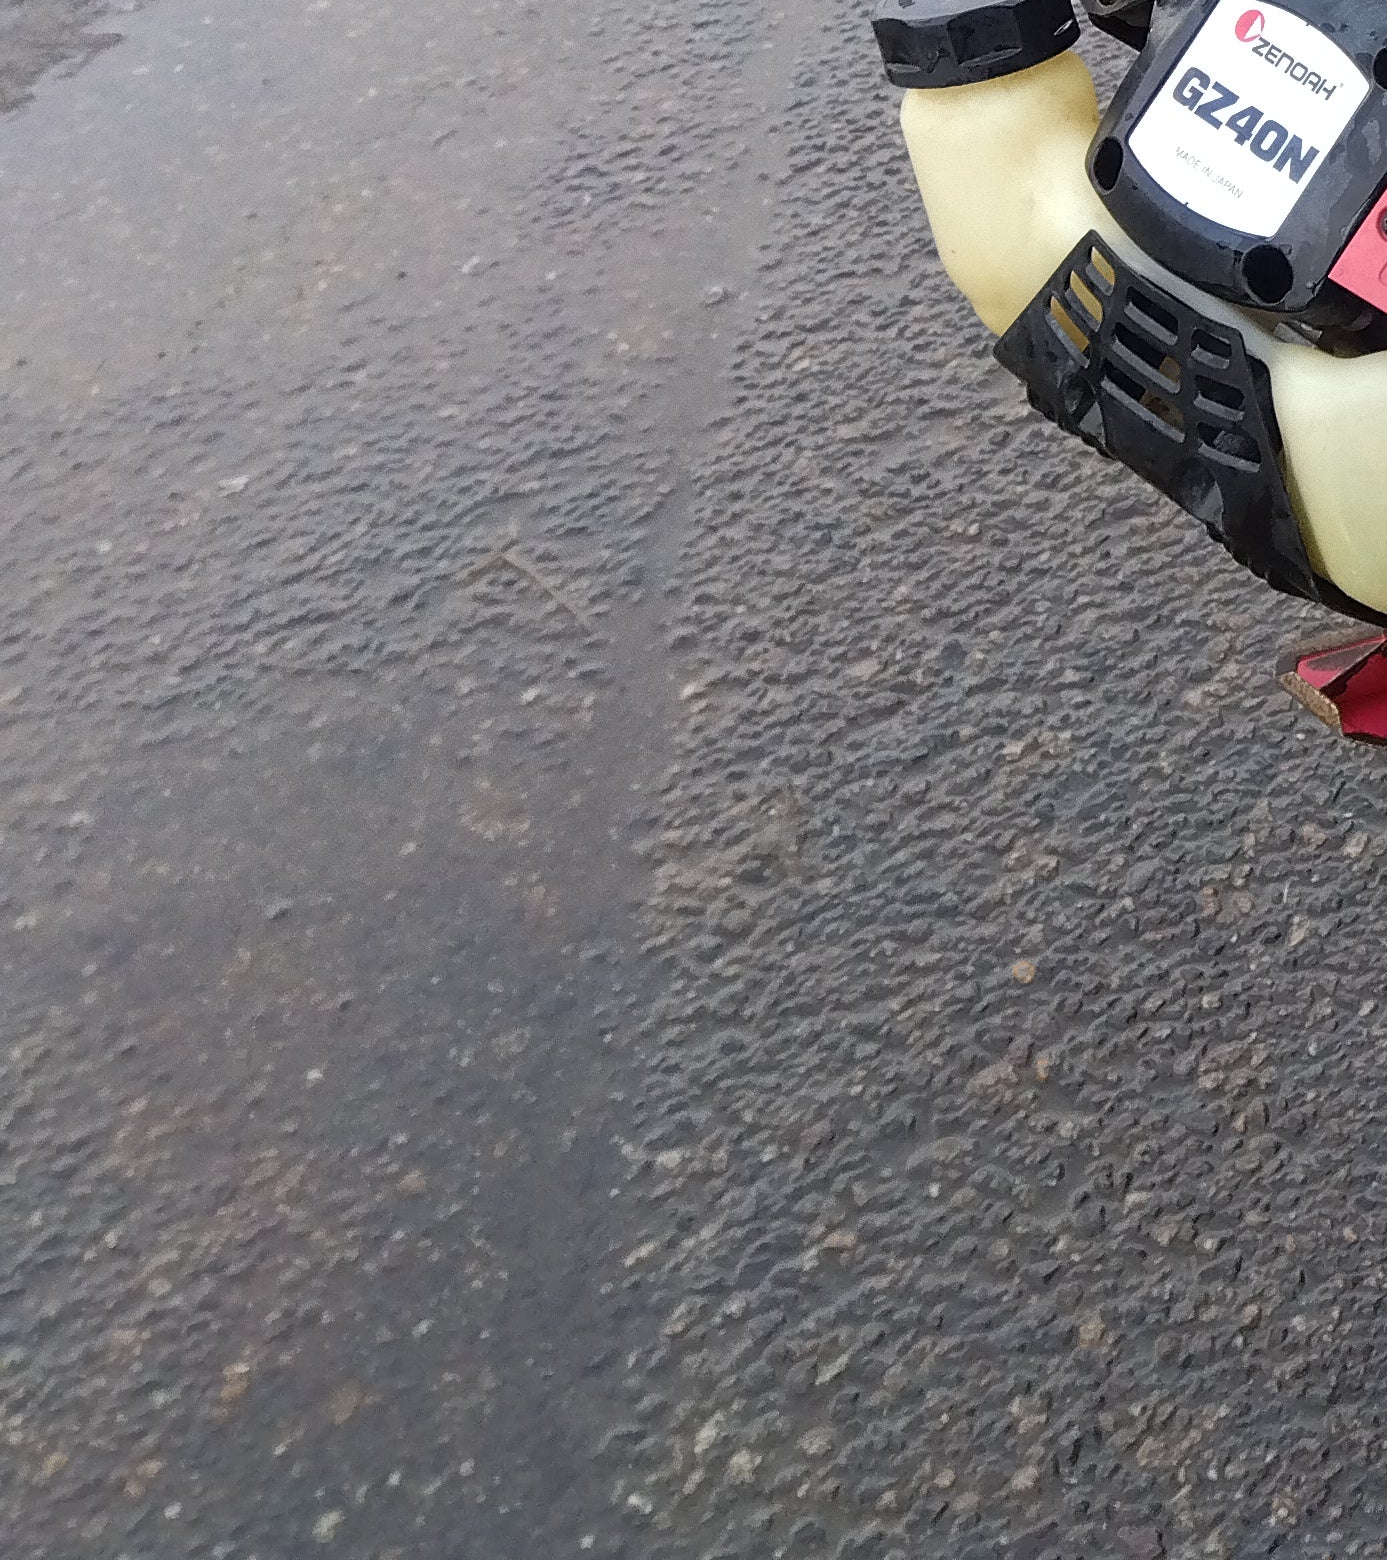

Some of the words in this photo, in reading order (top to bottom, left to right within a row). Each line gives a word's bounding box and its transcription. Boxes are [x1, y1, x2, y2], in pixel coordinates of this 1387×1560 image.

[1251, 36, 1337, 101] ZENOAH
[1172, 66, 1320, 184] GZ40N
[1175, 146, 1202, 169] MADE
[1201, 166, 1213, 178] IN
[1211, 174, 1244, 199] JAPAN
